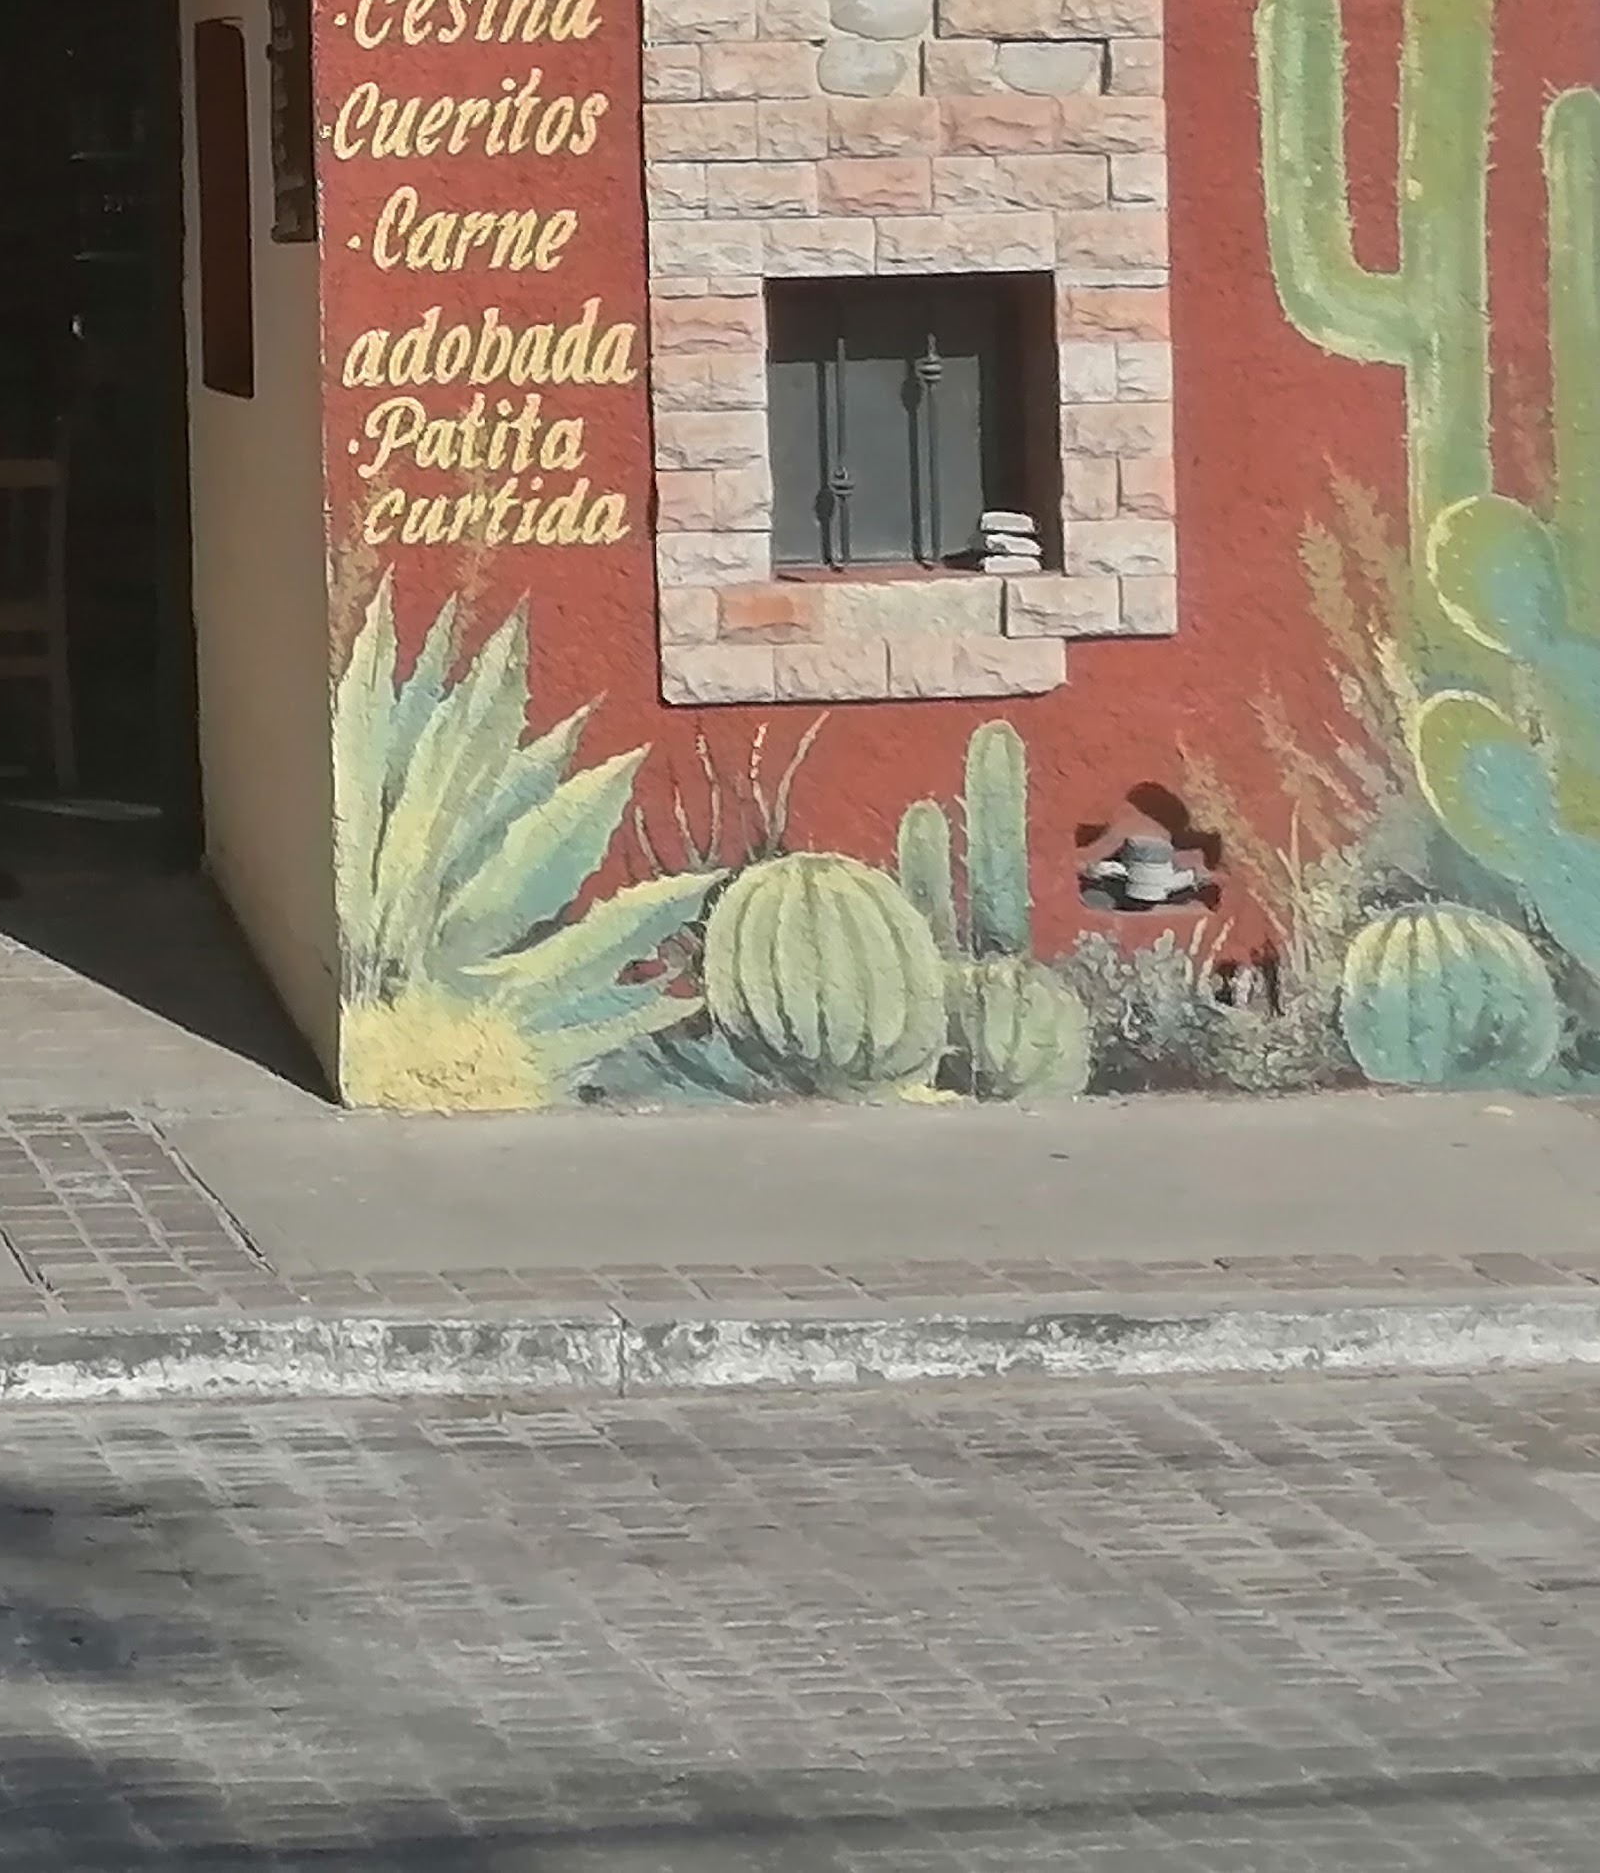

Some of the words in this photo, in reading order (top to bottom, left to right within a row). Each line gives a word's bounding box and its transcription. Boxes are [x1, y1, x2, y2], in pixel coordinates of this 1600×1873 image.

[332, 67, 609, 162] Cueritos
[372, 185, 579, 273] Carne
[341, 295, 638, 388] adobada
[357, 391, 587, 478] Patita
[361, 476, 632, 546] curtida
